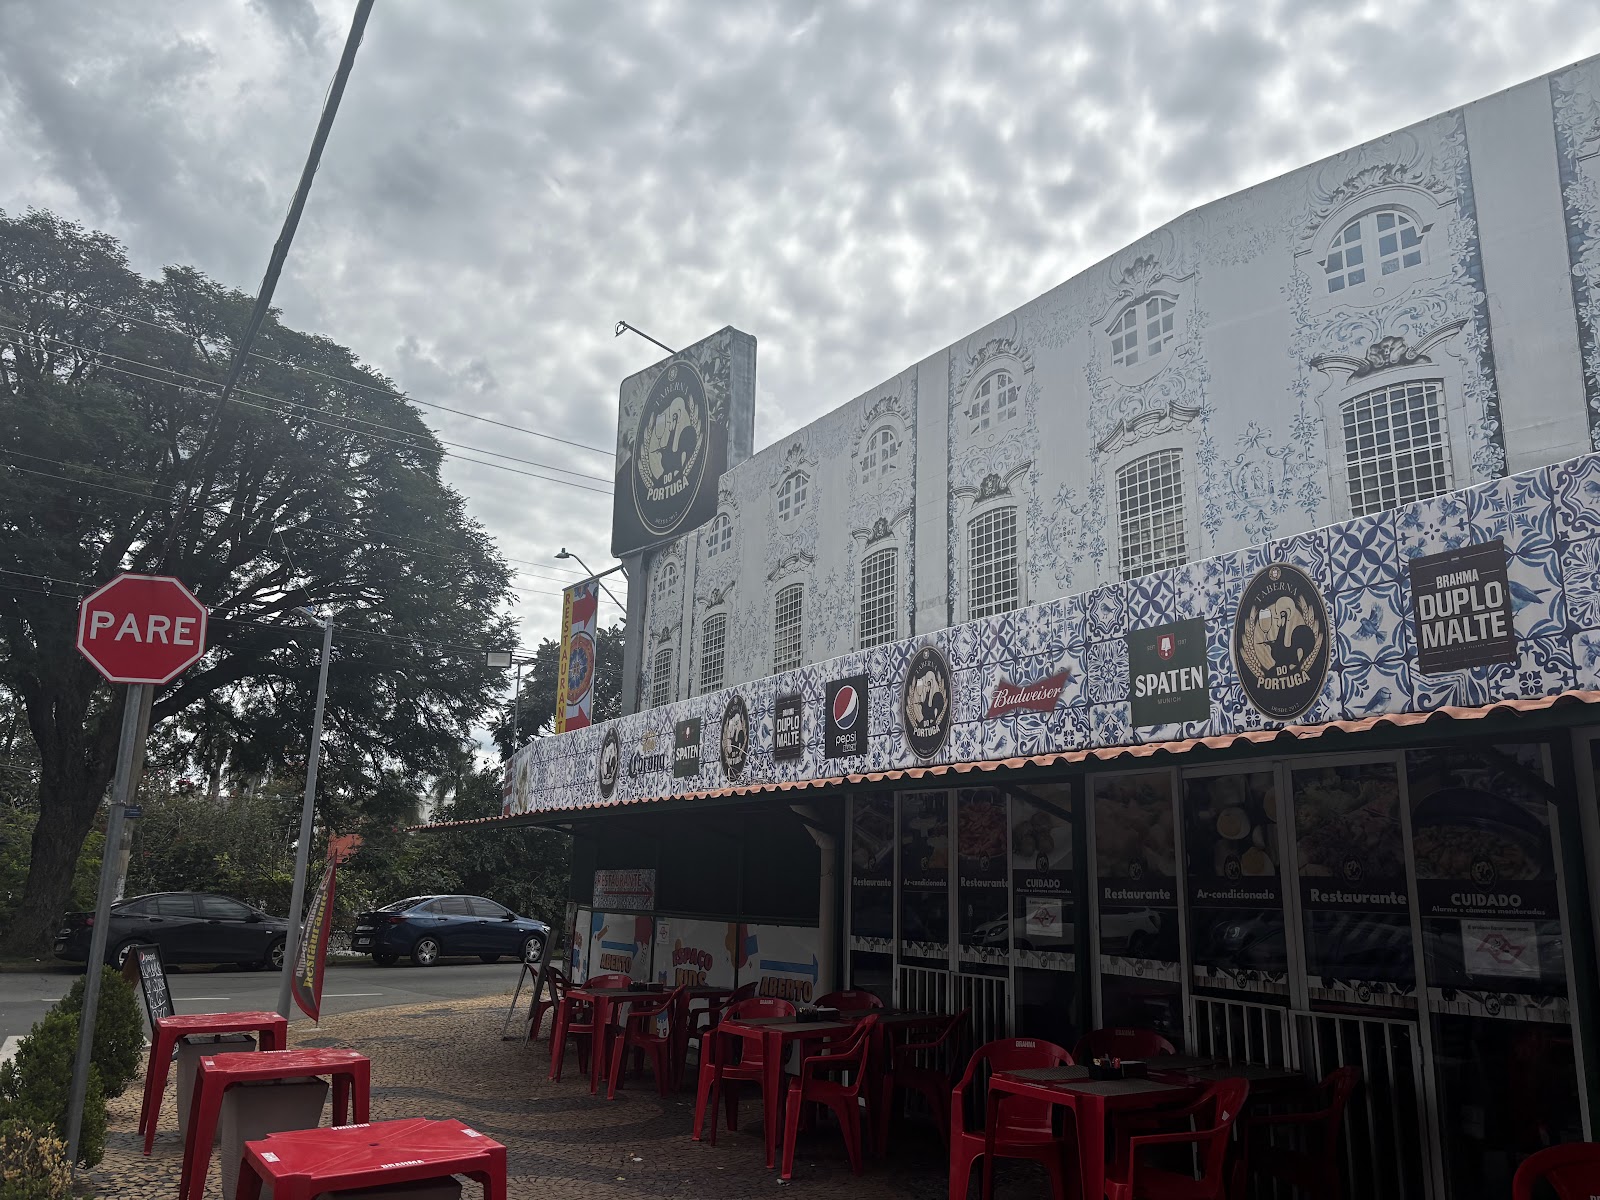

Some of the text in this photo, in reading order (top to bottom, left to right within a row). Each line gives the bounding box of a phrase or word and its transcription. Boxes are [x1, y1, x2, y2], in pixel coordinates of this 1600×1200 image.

[654, 382, 690, 407] TABERNA
[664, 474, 673, 485] DO
[646, 476, 690, 501] PORTUGA
[1436, 568, 1480, 590] BRAHMA
[1254, 581, 1298, 603] TABERNA
[1418, 580, 1504, 622] DUPLO
[89, 610, 196, 646] PARE
[1421, 610, 1508, 650] MALTE
[1276, 665, 1288, 676] DO
[1134, 665, 1204, 698] SPATEN
[1257, 671, 1311, 690] PORTUGA
[992, 686, 1063, 709] Budweiser
[1157, 696, 1182, 705] MUNICH
[777, 715, 799, 733] DUPLO
[913, 725, 941, 739] PORTUGA
[776, 731, 799, 748] MALTE
[835, 730, 857, 747] pepsi
[676, 745, 699, 761] SPATEN
[597, 873, 642, 887] RESTAURANTE
[853, 876, 892, 887] Restaurante
[1025, 878, 1061, 889] CUIDADO
[1104, 887, 1171, 900] Restaurante
[1196, 888, 1275, 900] Ar-condicionado
[1310, 888, 1407, 905] Restaurante
[1450, 893, 1522, 907] CUIDADO
[1431, 905, 1458, 913] Alarme
[1497, 907, 1546, 916] monitoradas
[303, 891, 329, 988] Restaurante
[600, 953, 632, 974] ABERTO
[672, 946, 713, 971] ESPAÇO
[759, 976, 813, 1003] ABERTO
[1015, 1040, 1036, 1048] BRAHMA
[380, 1159, 425, 1169] BRAHMA
